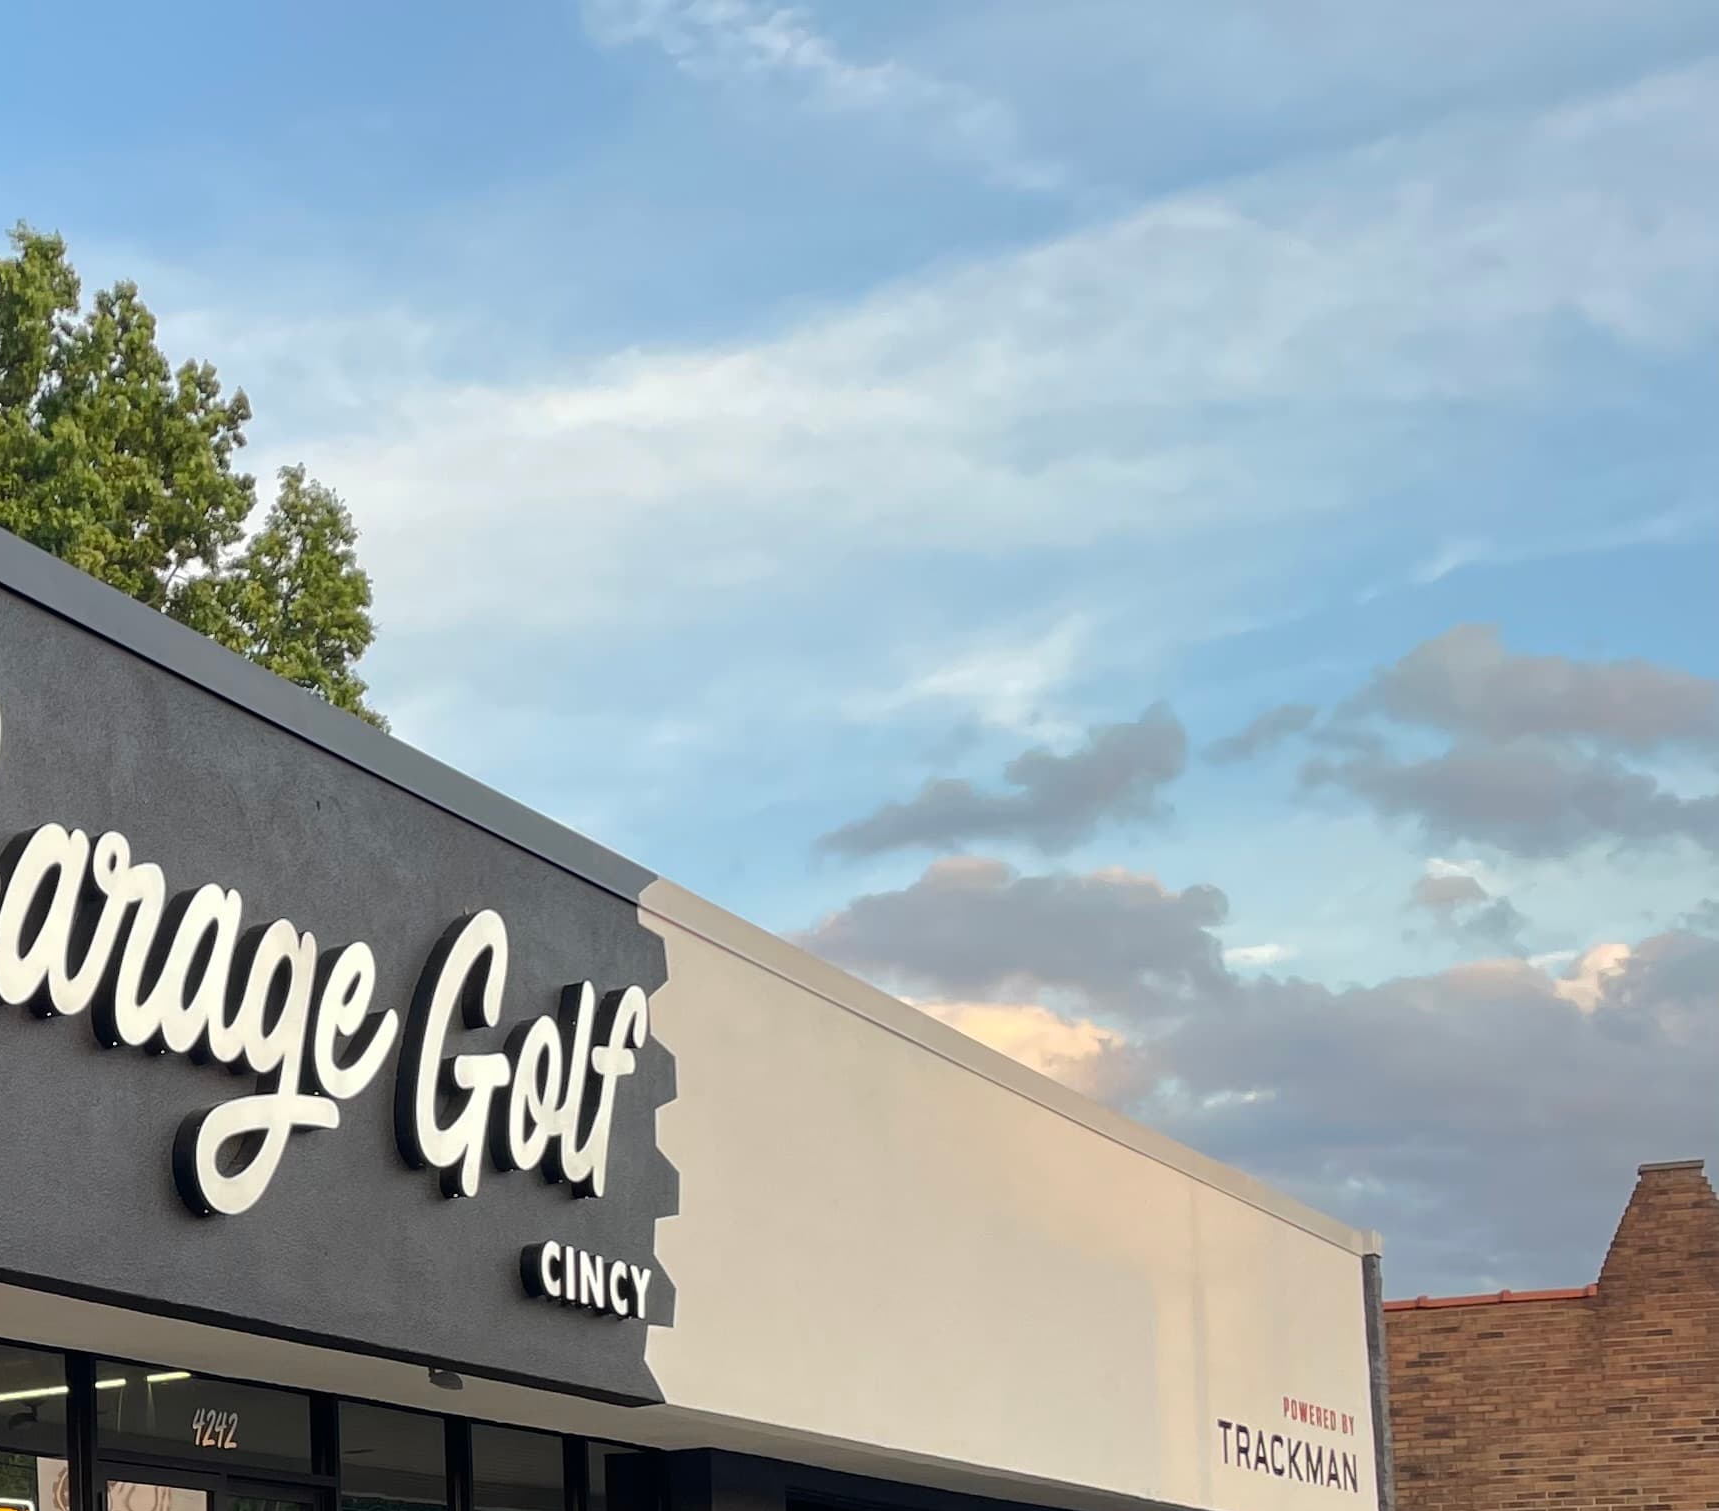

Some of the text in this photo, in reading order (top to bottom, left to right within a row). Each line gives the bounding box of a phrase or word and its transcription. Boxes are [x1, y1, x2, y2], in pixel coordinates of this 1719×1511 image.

[416, 909, 648, 1198] Golf
[541, 1241, 652, 1319] CINCY
[192, 1408, 238, 1449] 4242
[1283, 1396, 1354, 1436] POWERED BY
[1217, 1419, 1358, 1493] TRACKMAN
